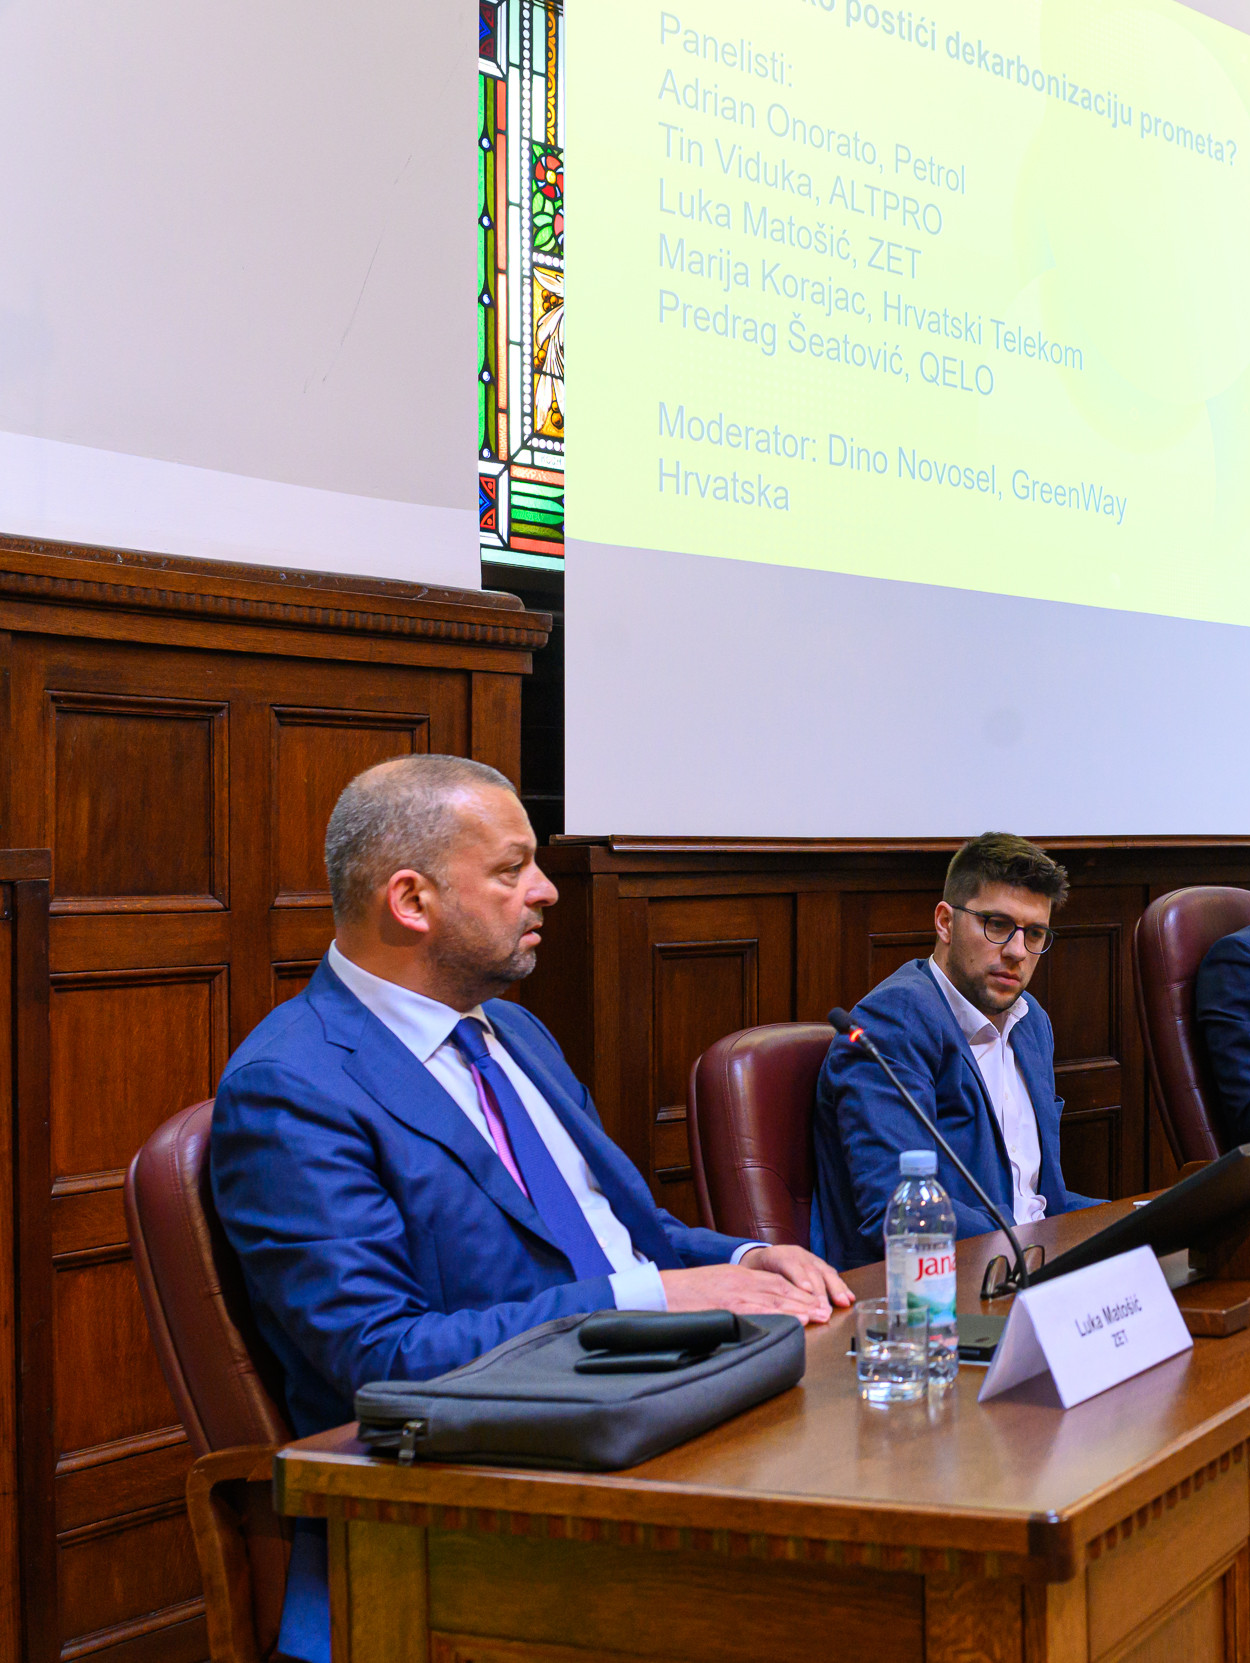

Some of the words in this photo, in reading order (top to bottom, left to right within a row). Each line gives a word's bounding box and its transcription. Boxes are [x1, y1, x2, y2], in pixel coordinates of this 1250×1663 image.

[660, 10, 793, 88] Panelisti:
[845, 0, 936, 52] postići
[945, 30, 1133, 129] dekarbonizaciju
[1140, 111, 1238, 167] prometa?
[657, 68, 756, 129] Adrian
[766, 102, 884, 175] Onorato,
[894, 143, 965, 196] Petrol
[657, 121, 704, 168] Tin
[714, 137, 820, 207] Viduka,
[828, 175, 943, 236] ALTPRO
[659, 177, 731, 230] Luka
[743, 200, 857, 269] Matošić,
[866, 235, 923, 280] ZET
[658, 232, 750, 293] Marija
[761, 258, 872, 324] Korajac,
[883, 290, 982, 346] Hrvatski
[989, 317, 1083, 372] Telekom
[658, 288, 777, 357] Predrag
[787, 319, 910, 384] Šeatović,
[919, 351, 994, 396] QELO
[658, 400, 817, 463] Moderator:
[828, 433, 889, 475] Dino
[897, 445, 1003, 502] Novosel,
[1011, 468, 1128, 526] GreenWay
[658, 457, 790, 512] Hrvatska
[1075, 1313, 1104, 1337] Luka
[1102, 1293, 1142, 1325] Matošić
[1112, 1329, 1128, 1348] ZET
